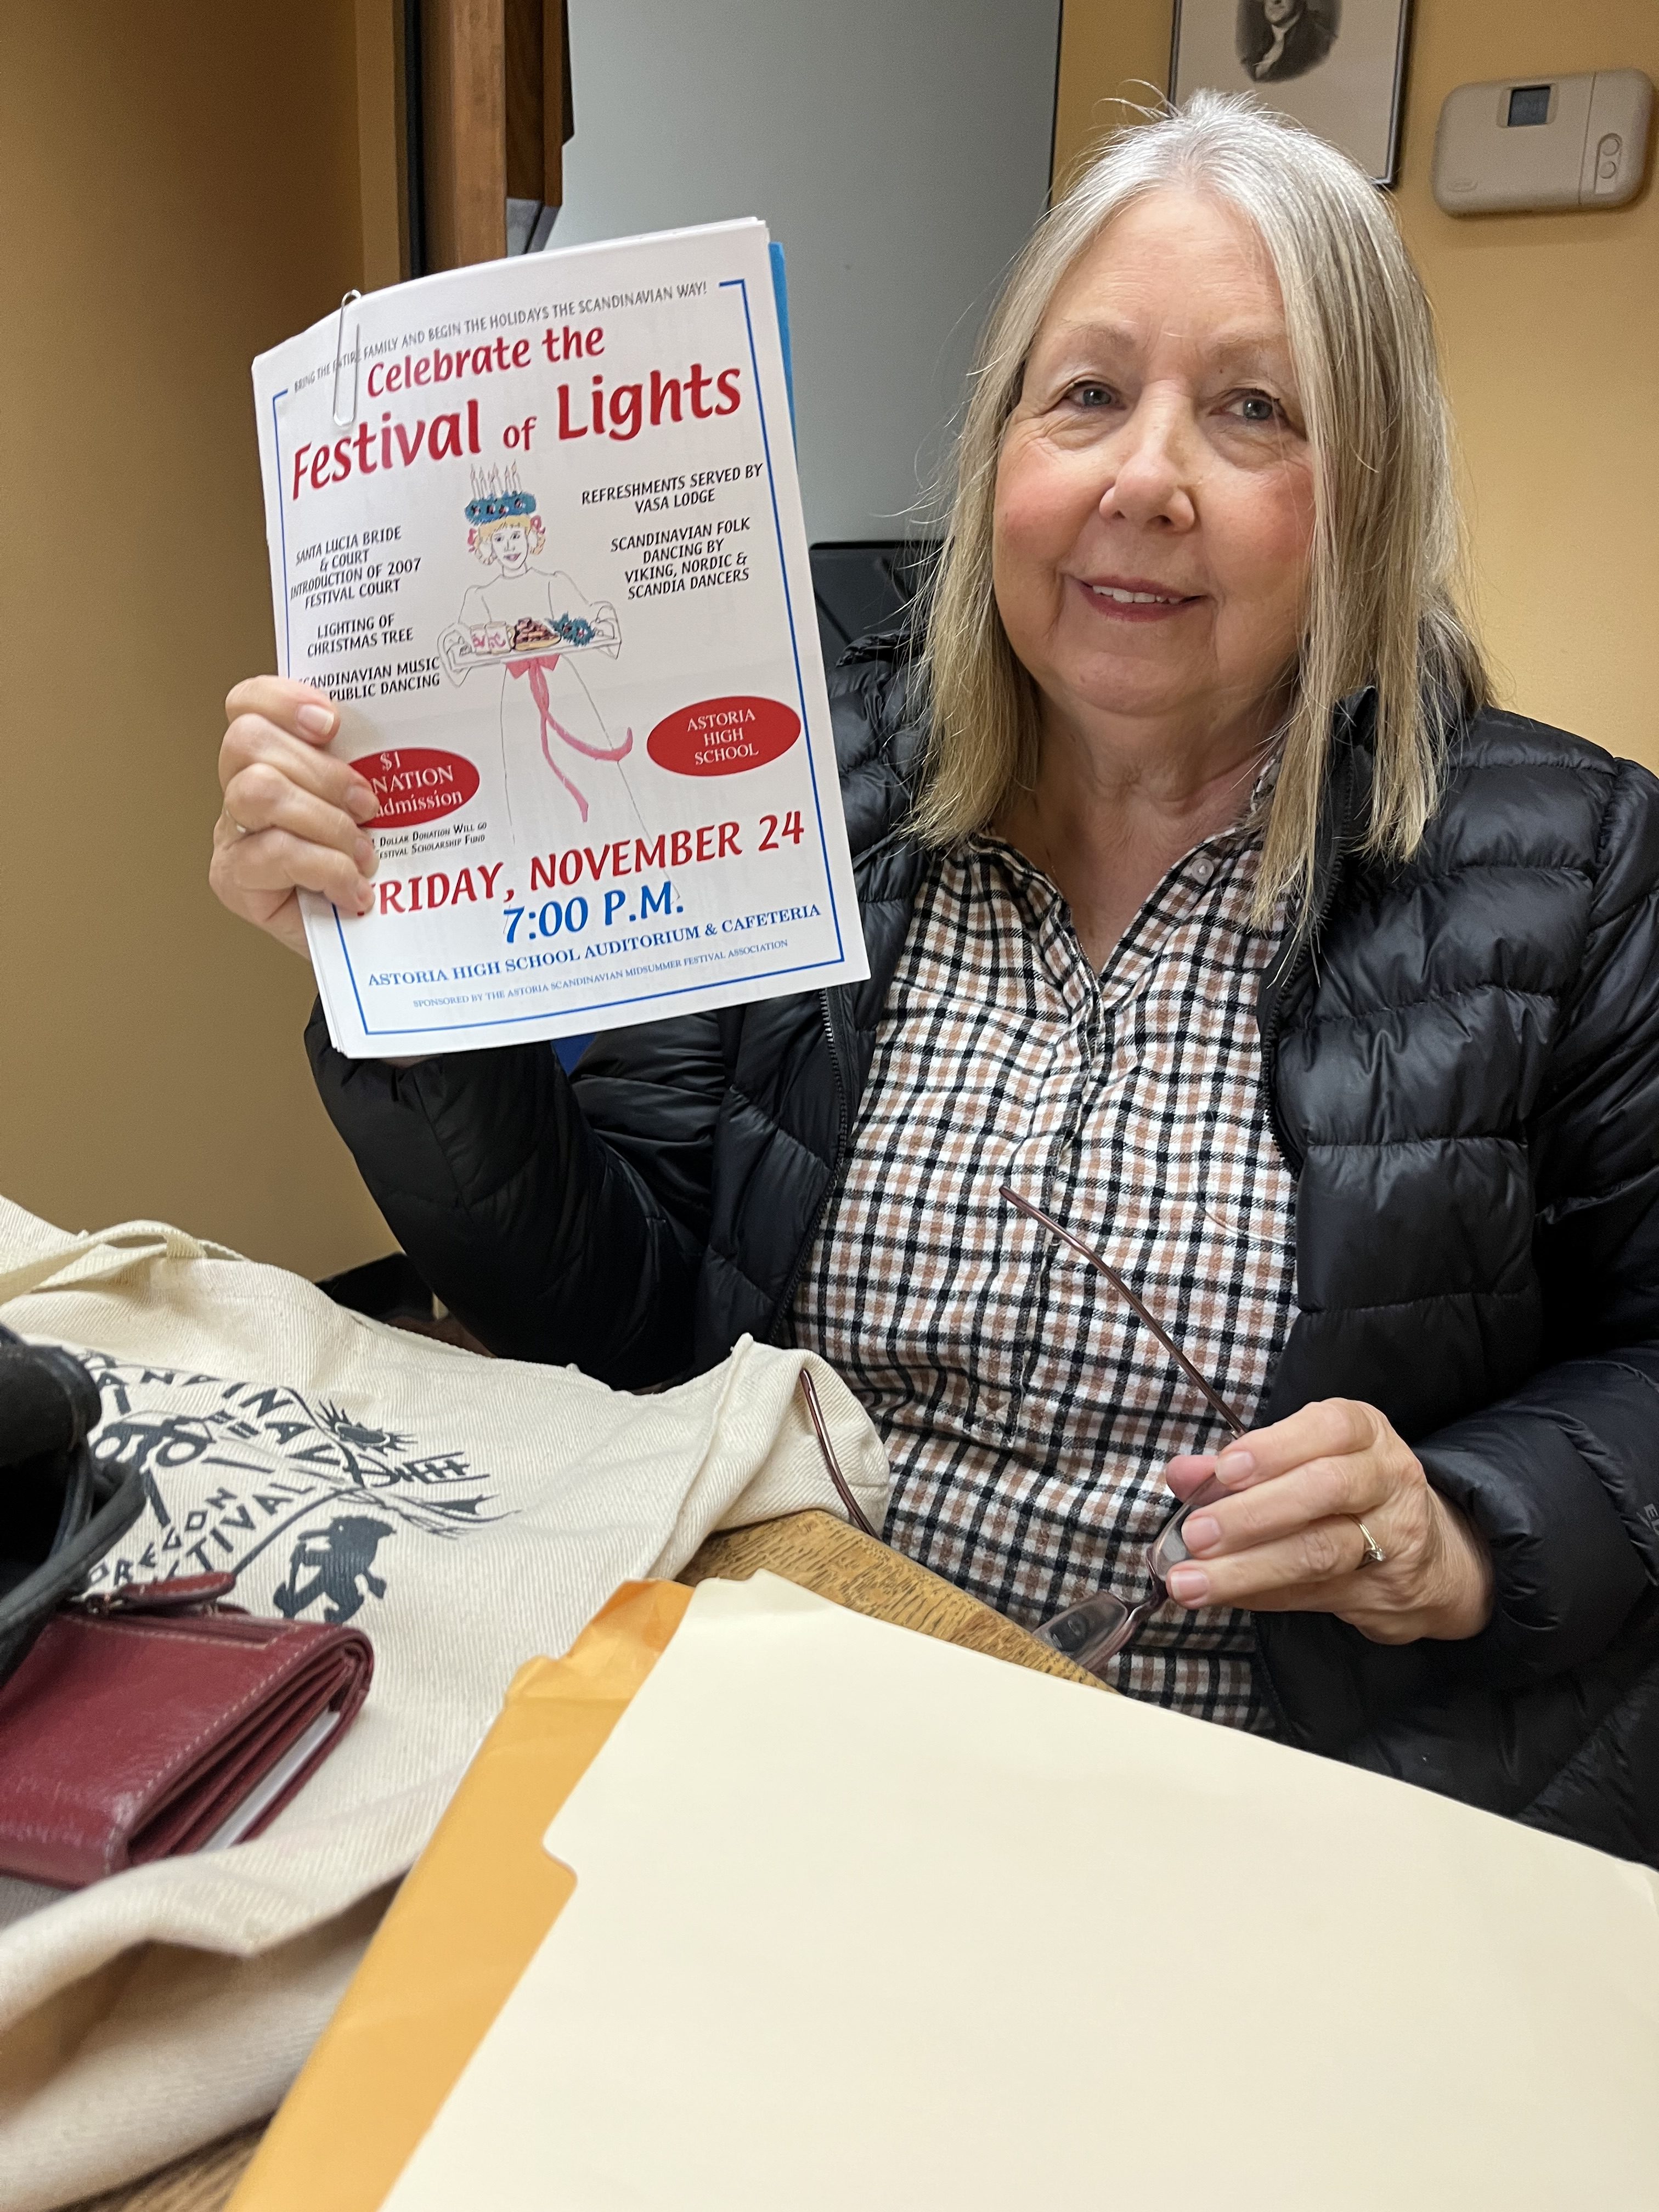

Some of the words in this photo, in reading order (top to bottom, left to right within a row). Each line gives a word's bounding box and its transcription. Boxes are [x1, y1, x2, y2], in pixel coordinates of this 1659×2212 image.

[294, 371, 315, 394] BRING
[317, 359, 331, 380] THE
[364, 337, 398, 360] FAMILY
[401, 330, 425, 349] AND
[428, 321, 461, 342] BEGIN
[465, 315, 487, 336] THE
[490, 304, 549, 329] HOLIDAYS
[552, 301, 575, 319] THE
[578, 285, 673, 312] SCANDINAVIAN
[677, 280, 707, 299] WAY!
[368, 336, 532, 398] Celebrate
[541, 325, 605, 363] the
[292, 398, 482, 501] Festival
[503, 416, 537, 452] of
[556, 362, 742, 442] Lights
[582, 475, 686, 505] REFRESHMENTS
[690, 466, 741, 488] SERVED
[745, 462, 764, 479] BY
[635, 496, 670, 515] VASA
[674, 488, 716, 509] LODGE
[295, 544, 323, 566] SANTA
[325, 533, 358, 554] LUCIA
[362, 526, 402, 546] BRIDE
[610, 523, 712, 552] SCANDINAVIAN
[717, 516, 751, 535] FOLK
[319, 557, 328, 573] &
[331, 548, 370, 569] COURT
[624, 563, 678, 584] VIKING,
[681, 554, 732, 574] NORDIC
[736, 551, 748, 566] &
[643, 541, 702, 565] DANCING
[707, 538, 725, 554] BY
[290, 567, 363, 601] INTRODUCTION
[367, 563, 383, 580] OF
[387, 557, 421, 577] 2007
[304, 586, 356, 611] FESTIVAL
[359, 577, 401, 598] COURT
[628, 578, 685, 600] SCANDIA
[690, 567, 749, 590] DANCERS
[307, 632, 378, 658] CHRISTMAS
[381, 627, 414, 646] TREE
[317, 616, 374, 640] LIGHTING
[379, 612, 395, 629] OF
[397, 656, 441, 676] MUSIC
[329, 682, 376, 703] PUBLIC
[380, 673, 440, 696] DANCING
[687, 708, 756, 733] ASTORIA
[703, 727, 744, 747] HIGH
[380, 750, 401, 772] $1
[695, 743, 759, 766] SCHOOL
[371, 765, 454, 794] NATION
[357, 861, 515, 917] RIDAY,
[531, 821, 743, 891] NOVEMBER
[758, 810, 805, 852] 24
[376, 848, 407, 860] ESTIVAL
[503, 896, 589, 944] 7:00
[604, 881, 684, 926] P.M.
[368, 969, 448, 987] ASTORIA
[453, 961, 501, 980] HIGH
[505, 948, 580, 973] SCHOOL
[584, 926, 700, 960] AUDITORIUM
[704, 923, 718, 937] &
[721, 904, 822, 934] CAFETERIA
[413, 994, 469, 1008] SPONSORED
[471, 992, 483, 1003] BY
[484, 989, 506, 1001] THE
[507, 984, 549, 998] ASTORIA
[550, 970, 624, 991] SCANDINAVIAN
[625, 960, 681, 977] MIDSUMMER
[684, 950, 726, 967] FESTIVAL
[727, 939, 788, 959] ASSOCIATION
